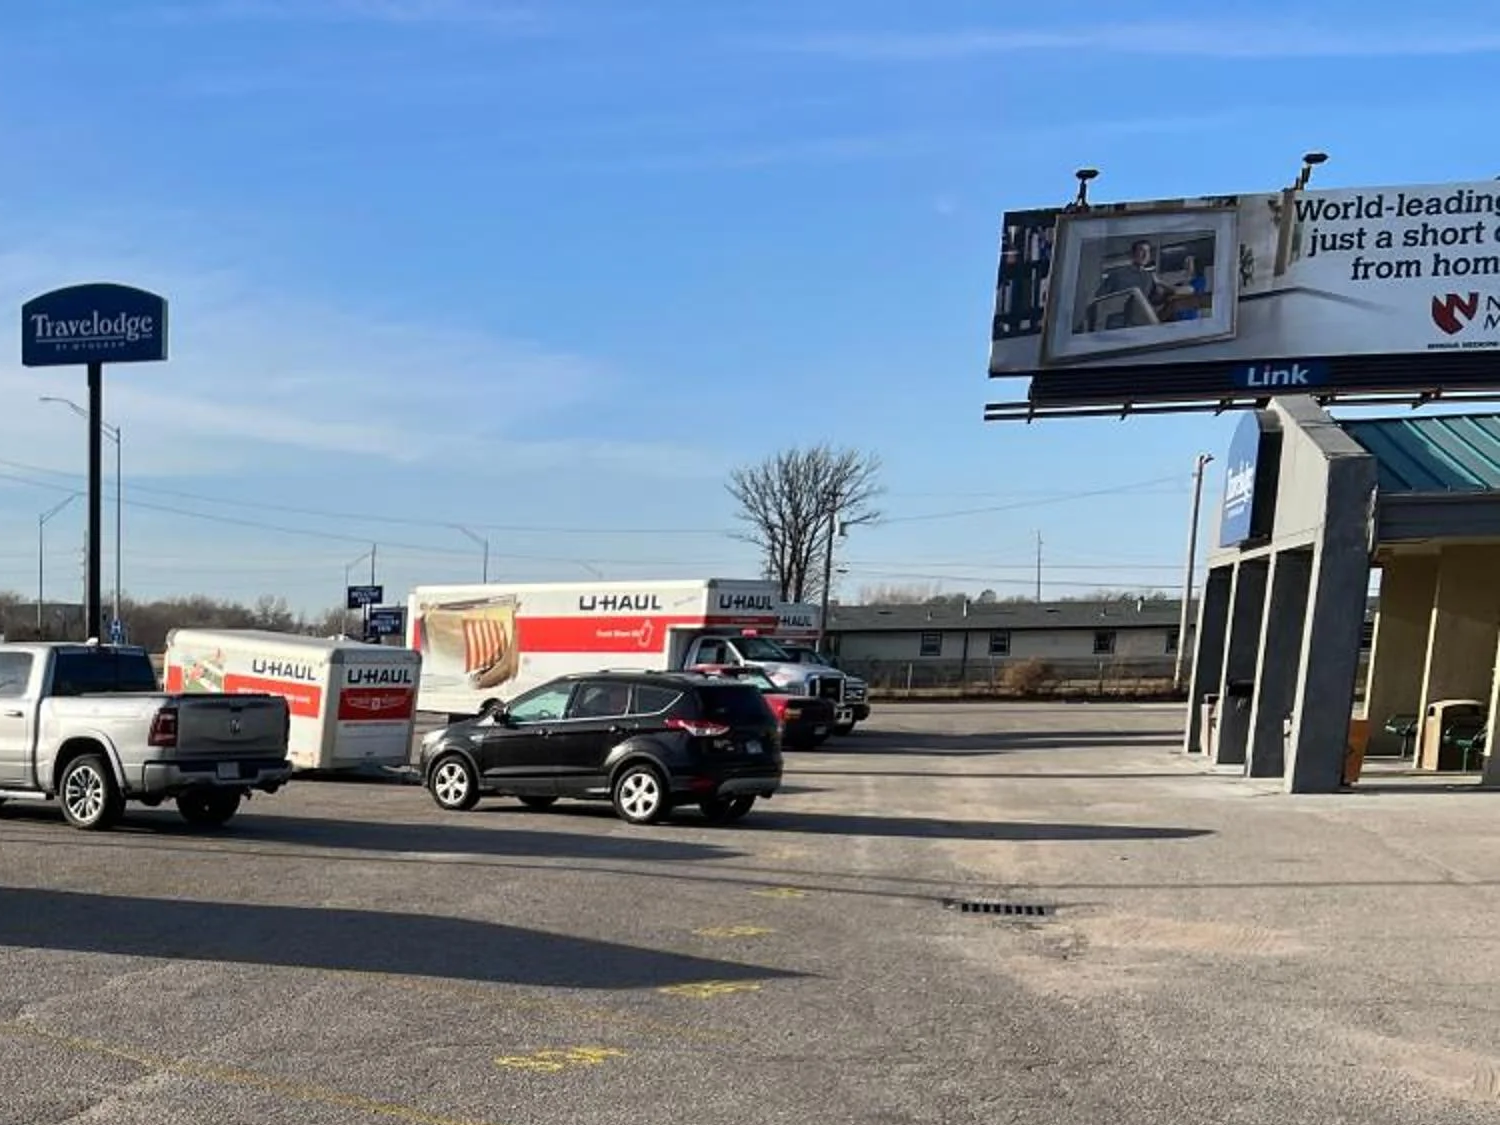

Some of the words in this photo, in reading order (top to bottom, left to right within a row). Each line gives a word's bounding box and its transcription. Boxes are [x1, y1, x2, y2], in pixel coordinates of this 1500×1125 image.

[1308, 227, 1367, 257] just
[1375, 230, 1393, 249] a
[1402, 221, 1485, 247] short
[1351, 256, 1422, 280] from
[30, 310, 153, 342] Travelodge
[1247, 364, 1309, 386] Link
[579, 594, 663, 611] U-HAUL
[720, 594, 774, 610] U-HAUL
[777, 615, 813, 627] -HAUL
[252, 659, 317, 681] U-HAUL
[347, 669, 412, 684] U-HAUL
